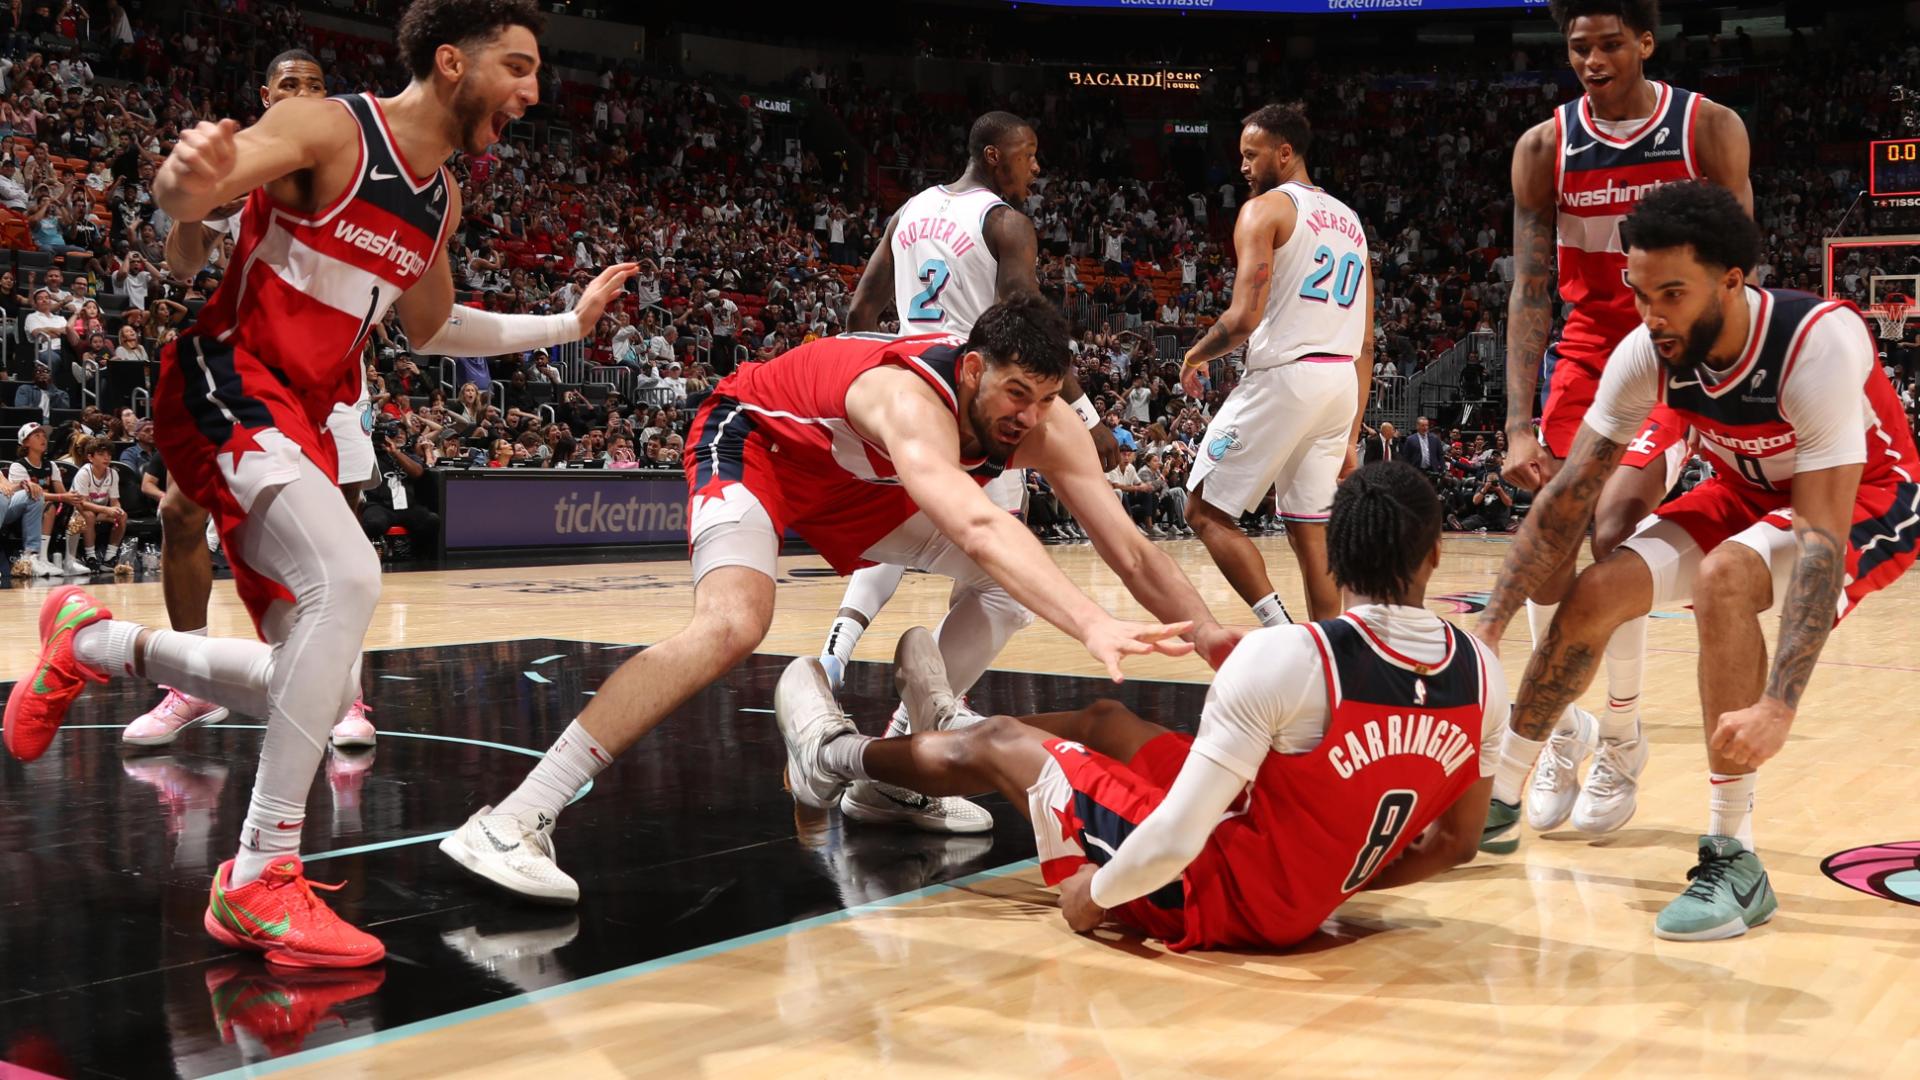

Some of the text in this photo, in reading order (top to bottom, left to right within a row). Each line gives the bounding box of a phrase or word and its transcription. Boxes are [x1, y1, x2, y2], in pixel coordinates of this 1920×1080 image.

[1167, 82, 1200, 90] LOUNG
[755, 99, 792, 113] ACARDÍ
[1175, 124, 1209, 134] BACARDÍ
[1888, 144, 1916, 161] 0.0
[1564, 178, 1691, 208] washin
[897, 217, 976, 258] ROZIER III
[907, 258, 951, 324] 2
[1299, 244, 1365, 310] 20
[1328, 713, 1476, 778] CARRINGTON
[1341, 788, 1418, 894] 8
